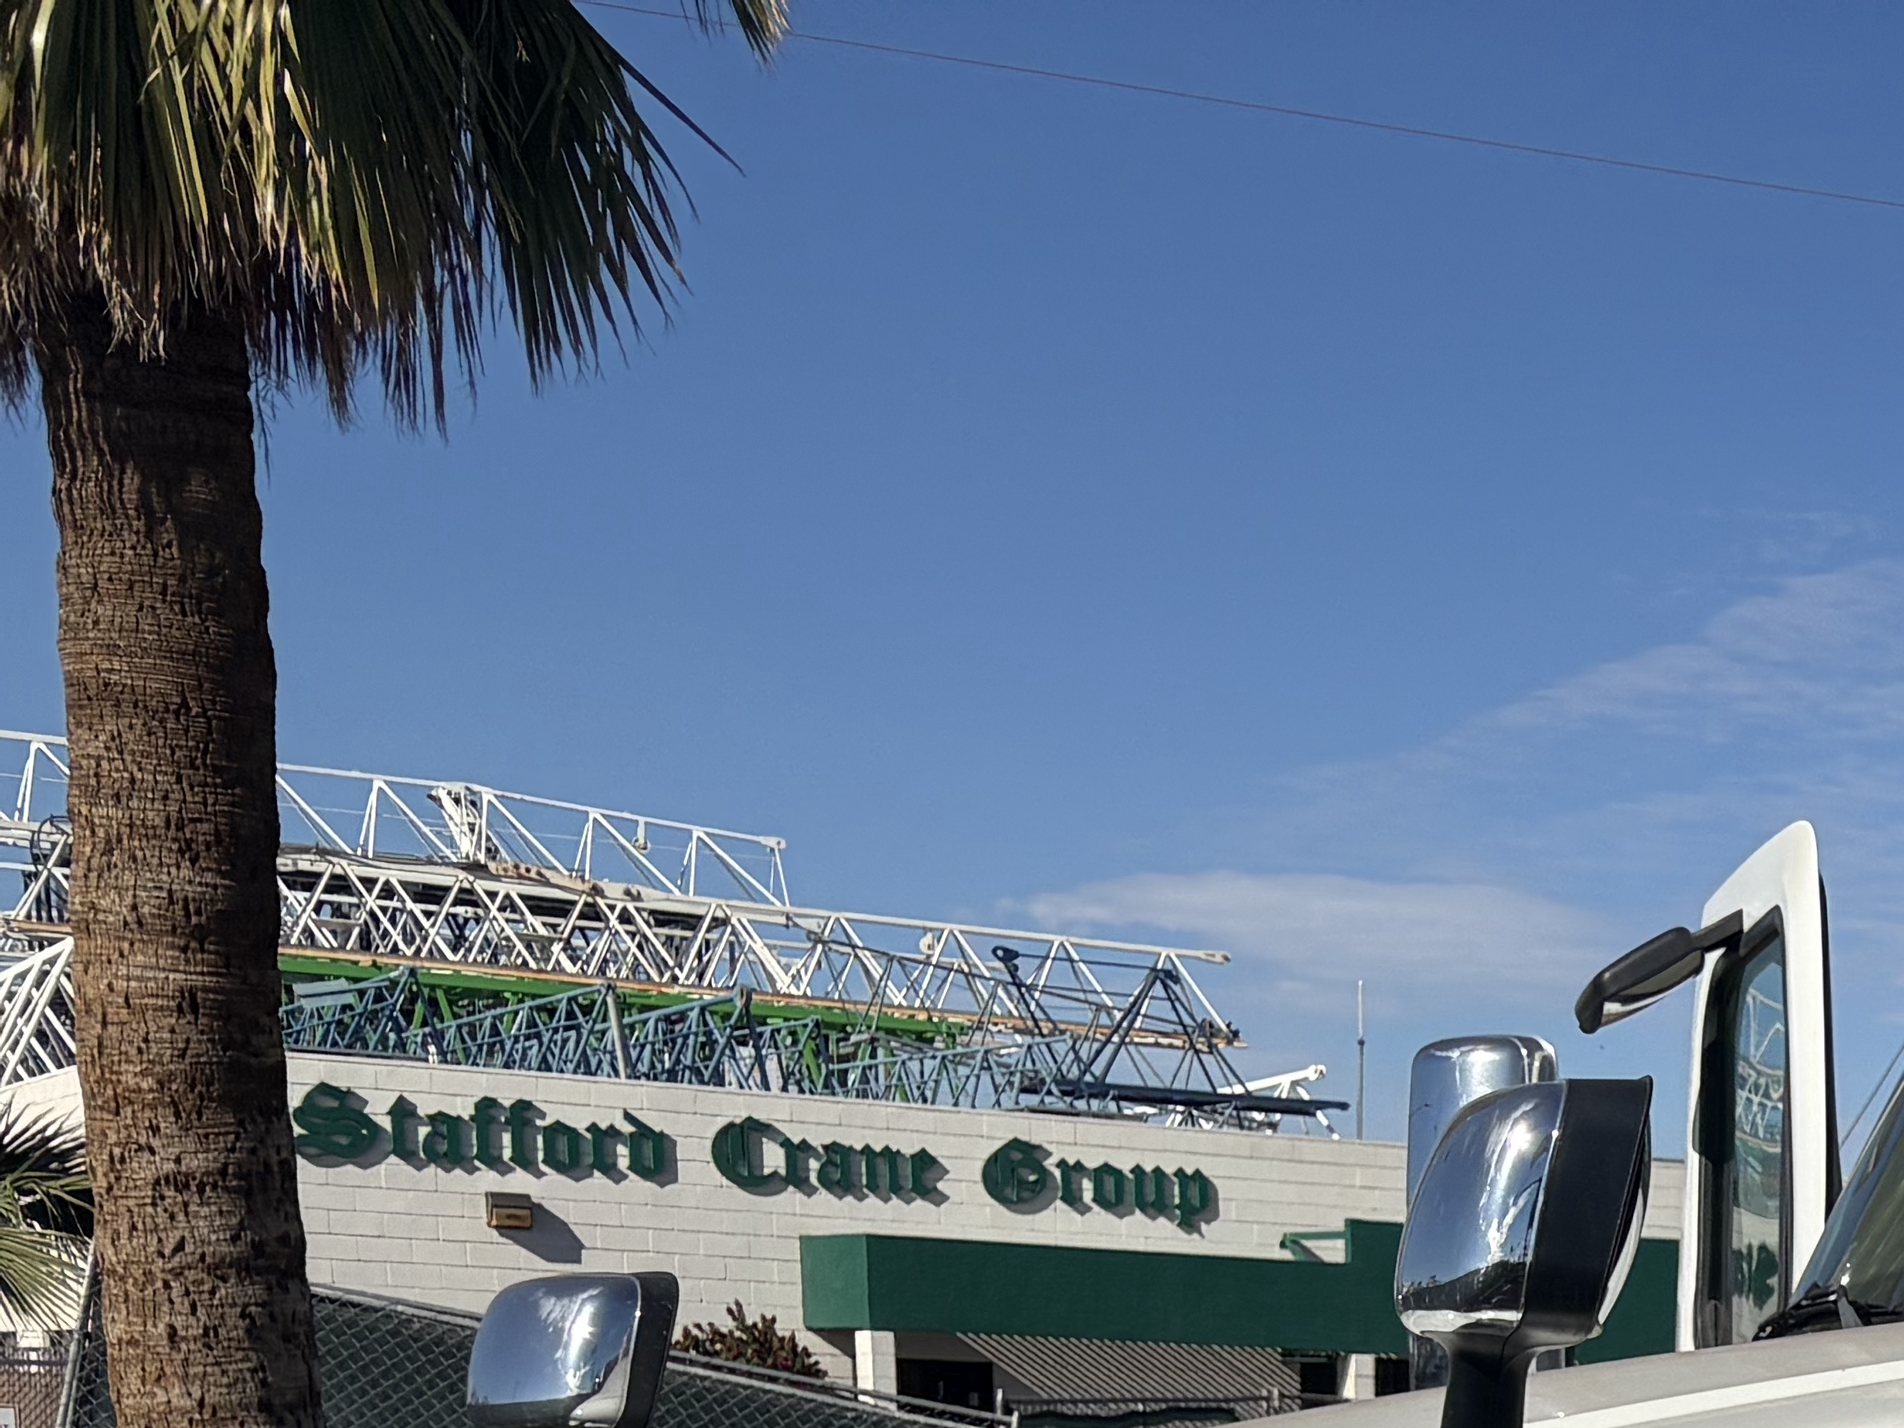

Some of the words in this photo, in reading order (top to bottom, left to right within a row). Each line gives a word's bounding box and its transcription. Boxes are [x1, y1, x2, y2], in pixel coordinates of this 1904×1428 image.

[294, 1082, 667, 1182] Stafford
[713, 1117, 943, 1201] Crane
[983, 1137, 1212, 1232] Group
